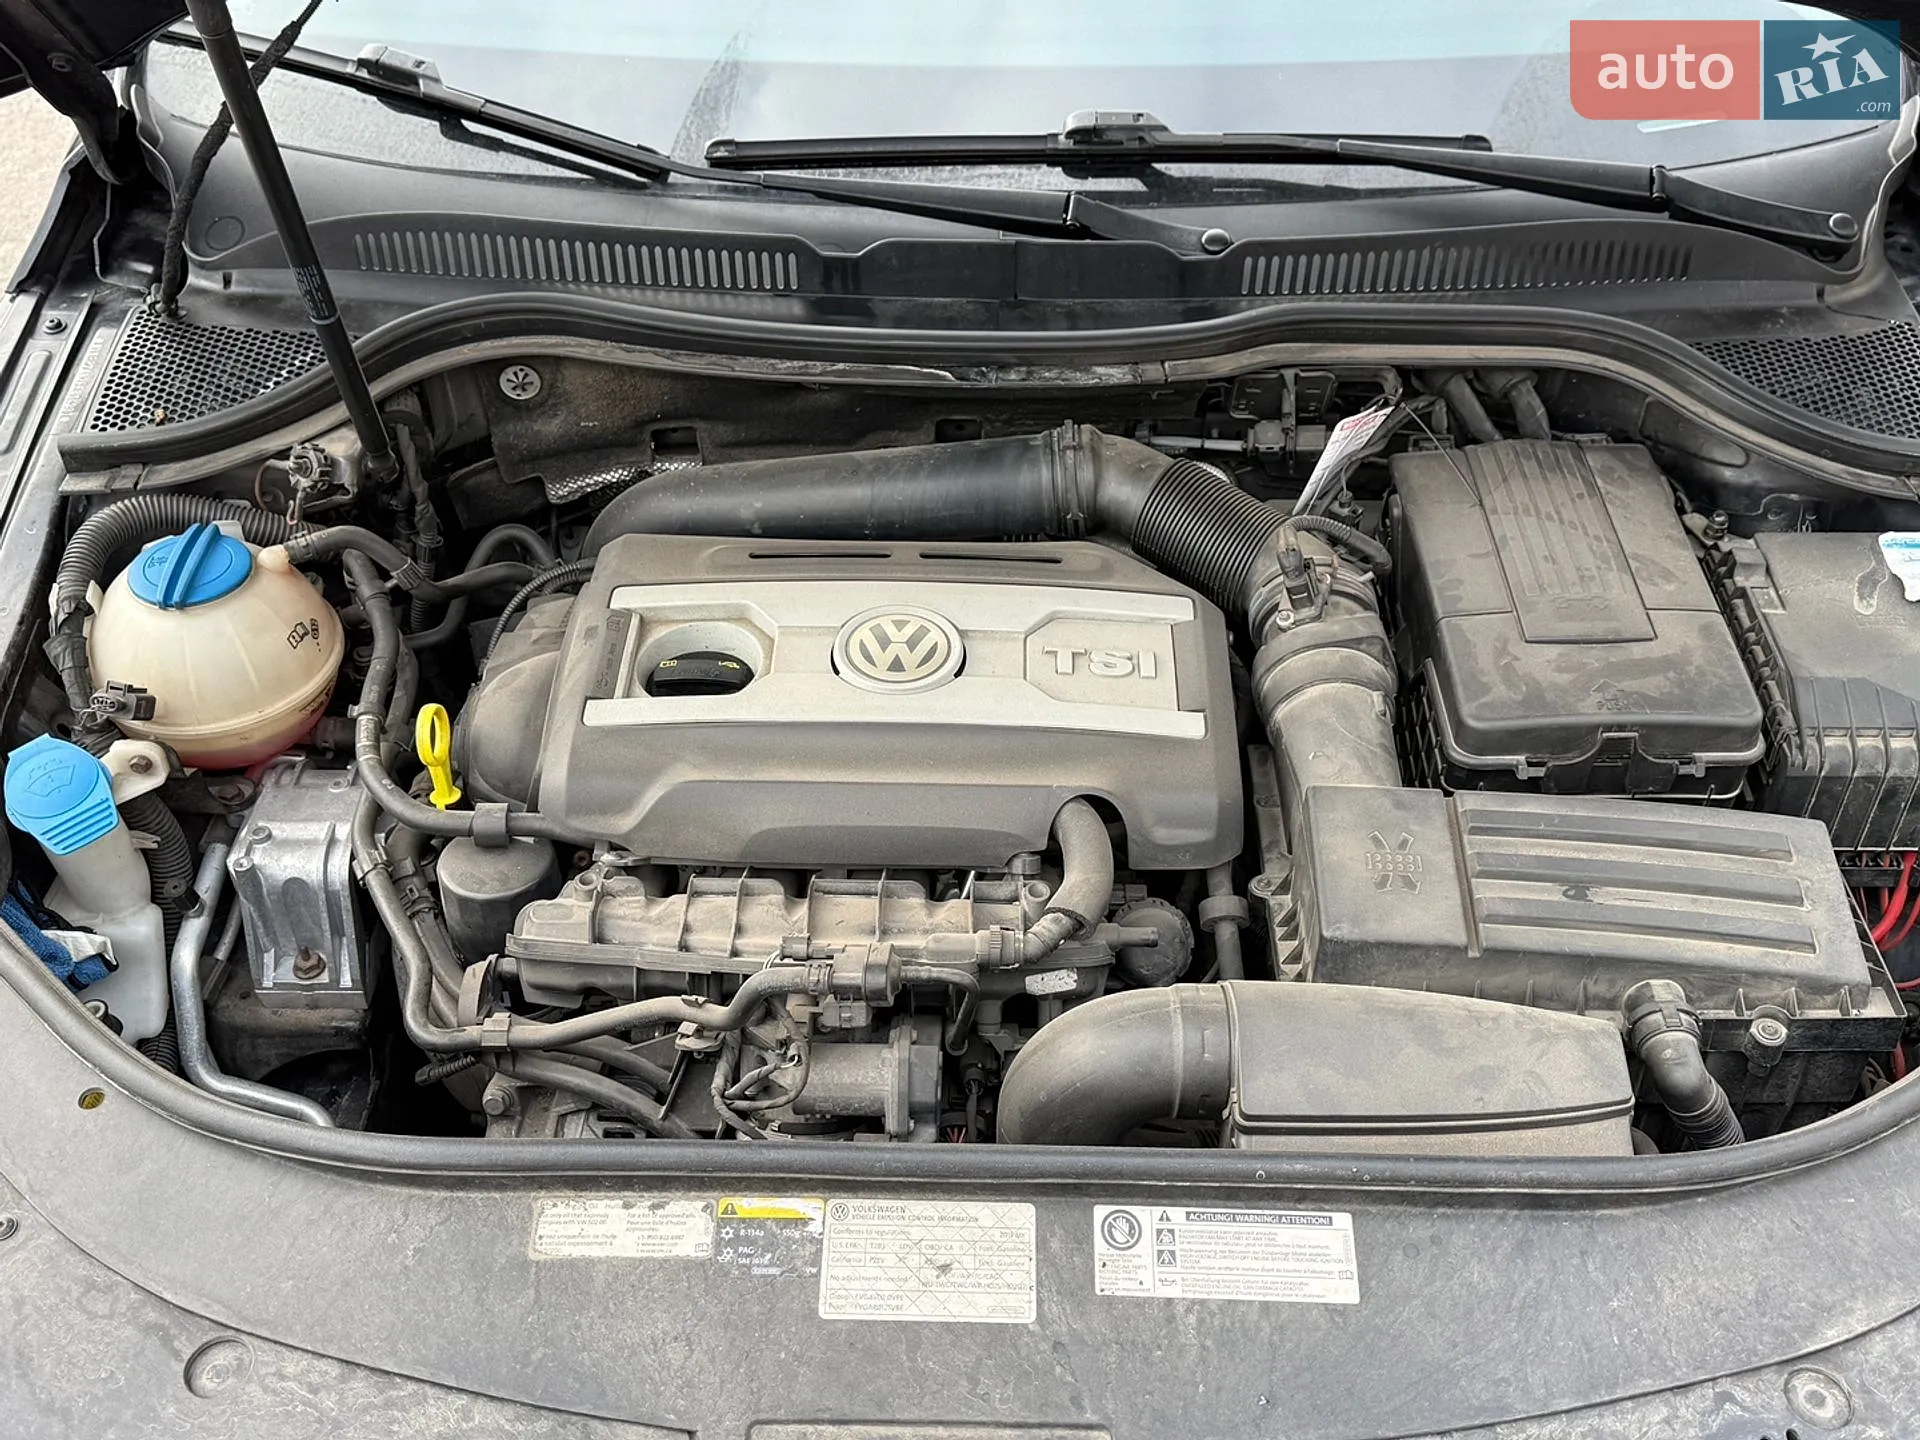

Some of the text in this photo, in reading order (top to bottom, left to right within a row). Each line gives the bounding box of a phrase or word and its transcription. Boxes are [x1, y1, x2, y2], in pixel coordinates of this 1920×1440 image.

[1041, 645, 1157, 680] TSI
[852, 1205, 906, 1213] VOLKSWAGEN
[1189, 1213, 1330, 1225] ACHTUNG! WARNING! ATTENTION!
[738, 1246, 755, 1255] PAG
